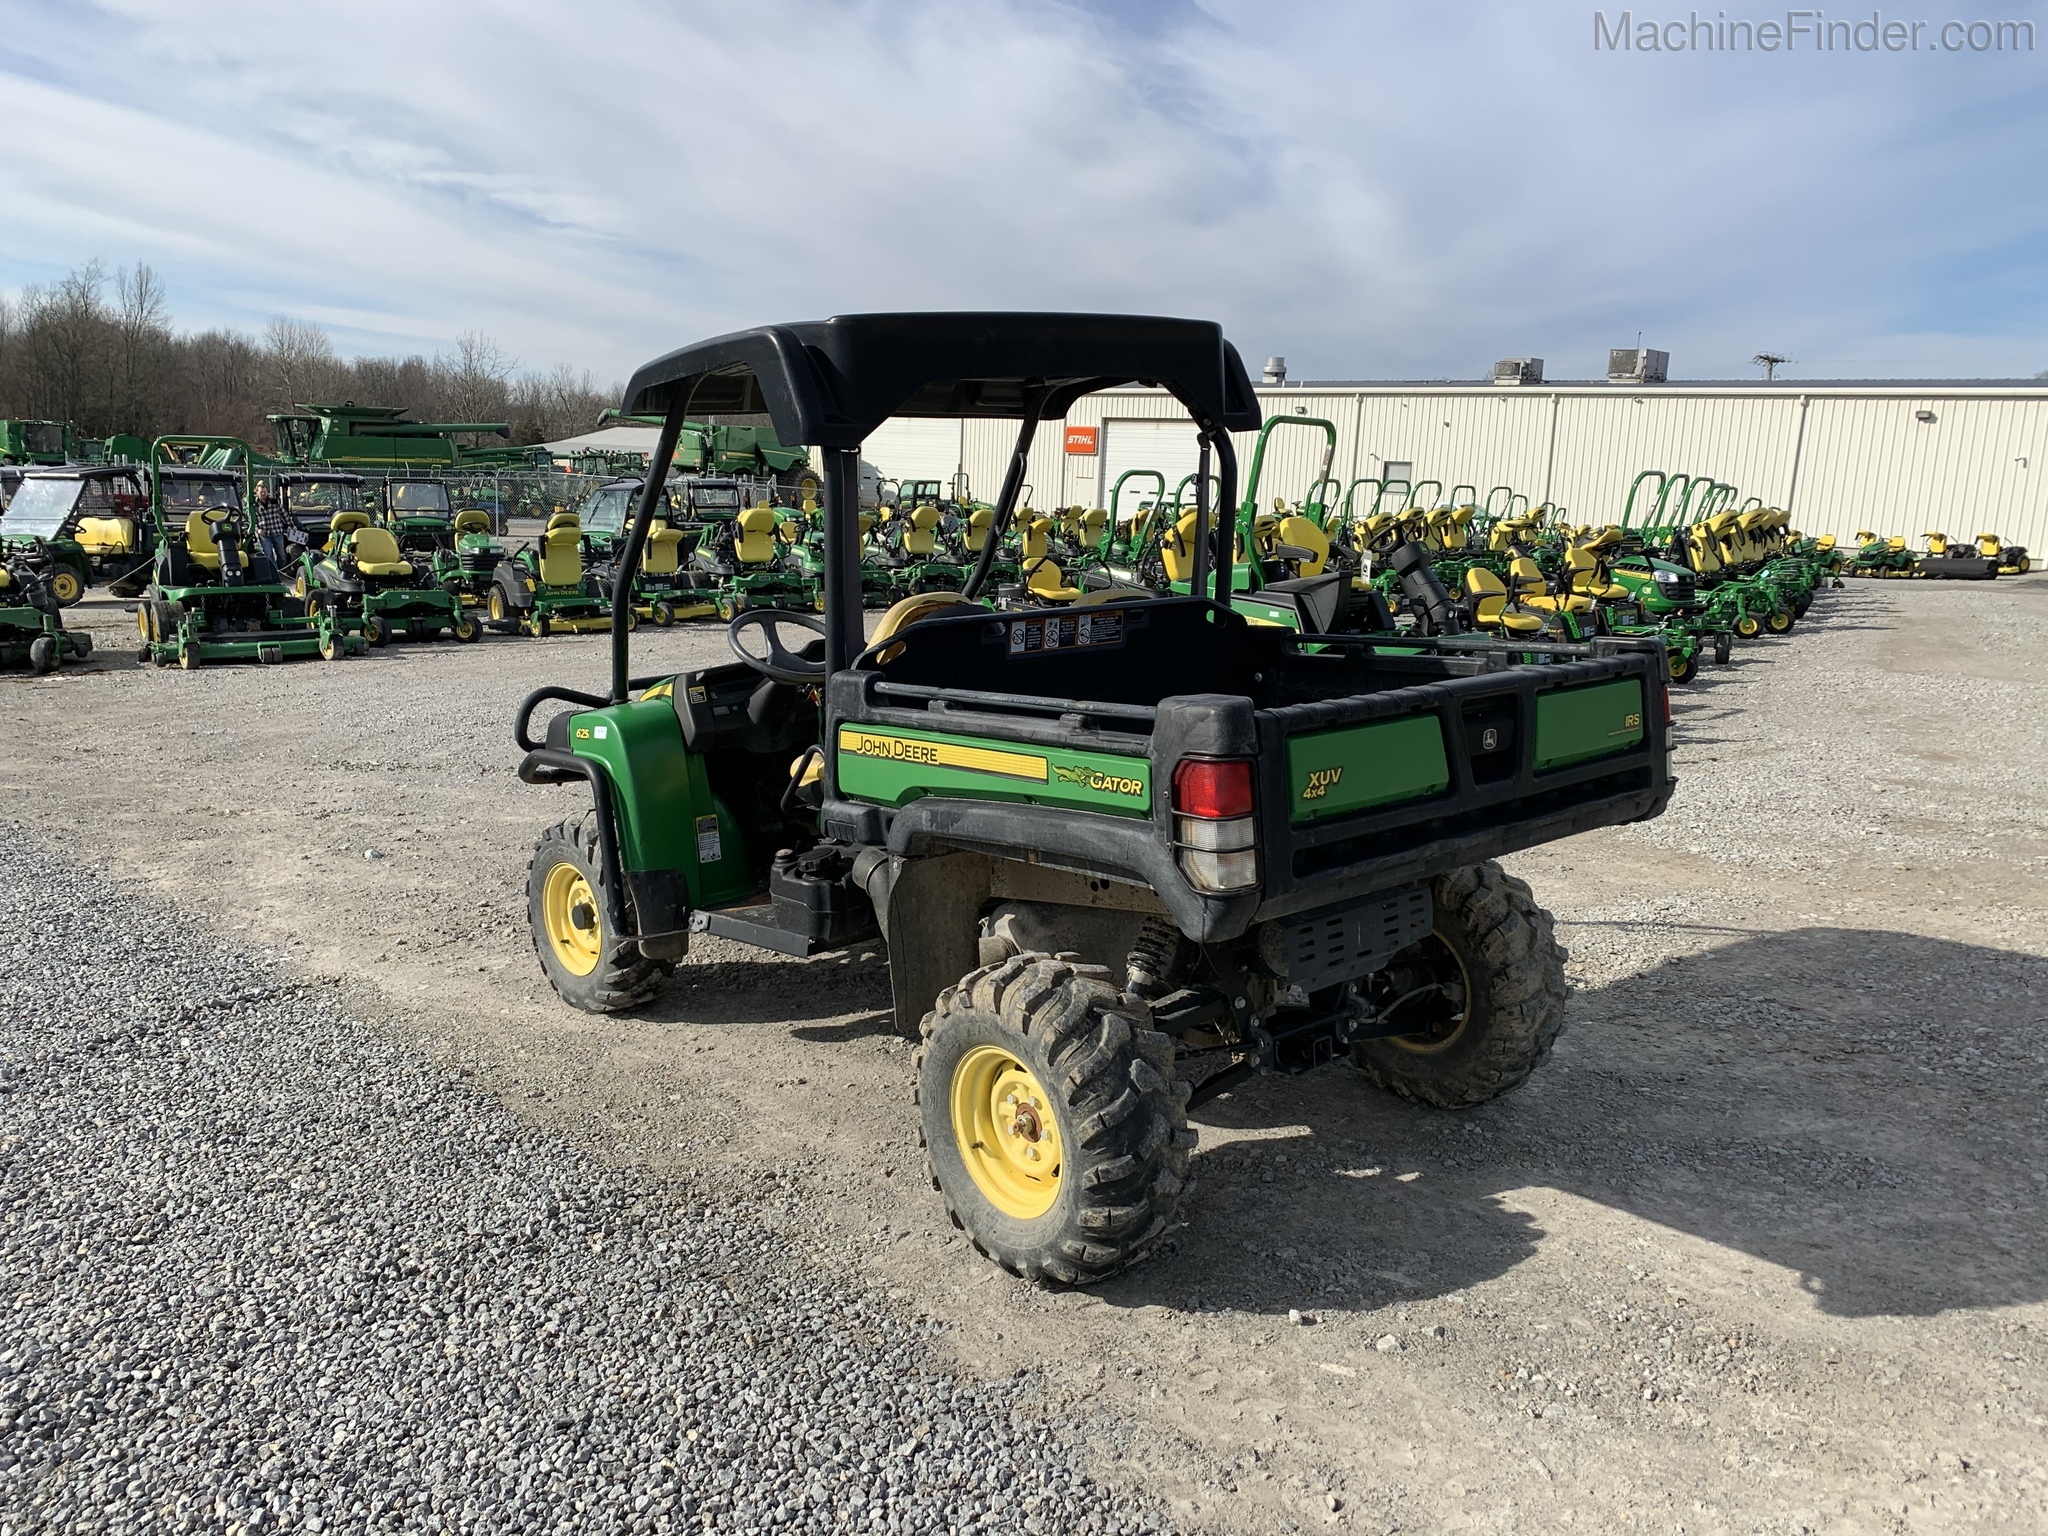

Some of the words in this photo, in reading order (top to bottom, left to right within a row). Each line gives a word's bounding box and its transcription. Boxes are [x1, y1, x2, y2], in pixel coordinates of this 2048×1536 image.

[1067, 435, 1094, 445] STIHL
[1625, 713, 1640, 727] IRS
[856, 735, 891, 756] JOHN
[893, 740, 938, 763] DEERE
[1089, 772, 1144, 797] GATOR
[1309, 767, 1342, 788] XUV
[1303, 785, 1326, 799] 4x4
